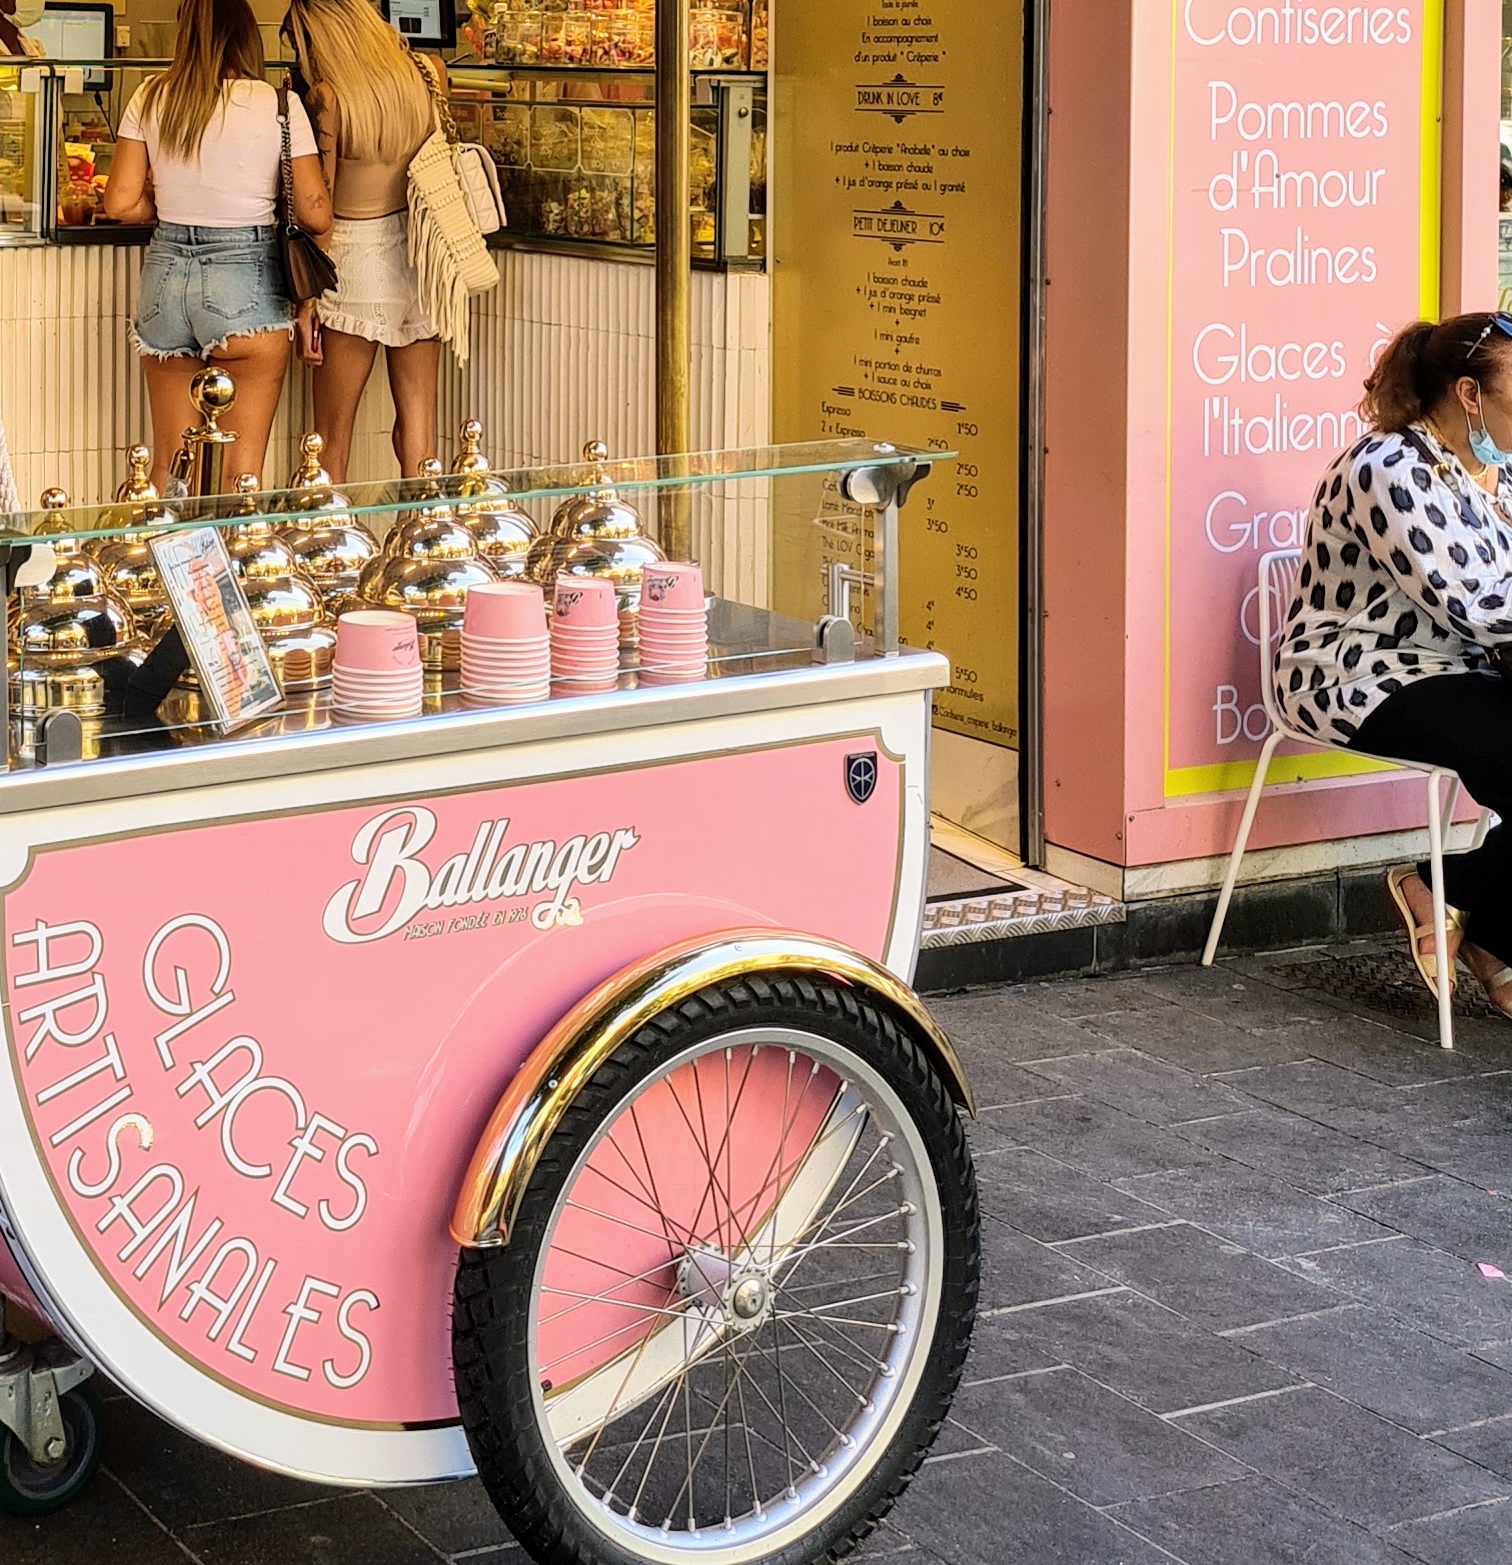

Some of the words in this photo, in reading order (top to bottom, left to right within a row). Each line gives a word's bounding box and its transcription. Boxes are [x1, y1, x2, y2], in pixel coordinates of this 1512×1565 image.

[873, 33, 939, 47] accompagnement
[857, 91, 884, 105] DRUNK
[887, 91, 894, 105] IN
[896, 91, 920, 106] LOVE
[1207, 81, 1389, 141] Pommes
[1208, 148, 1386, 212] d'Amour
[853, 216, 873, 231] PETIT
[1219, 228, 1377, 288] Pralines
[1192, 323, 1346, 385] Glaces
[858, 388, 897, 404] BOISSONS
[900, 394, 937, 410] CHAUDES
[1202, 393, 1370, 457] l'Italienn
[323, 805, 641, 944] Ballanger
[404, 919, 445, 942] MAISON
[447, 912, 489, 934] FONDÉE
[492, 910, 508, 925] EN
[508, 906, 529, 924] 1926
[143, 912, 379, 1231] GLACES
[12, 918, 381, 1389] ARTISANALES
